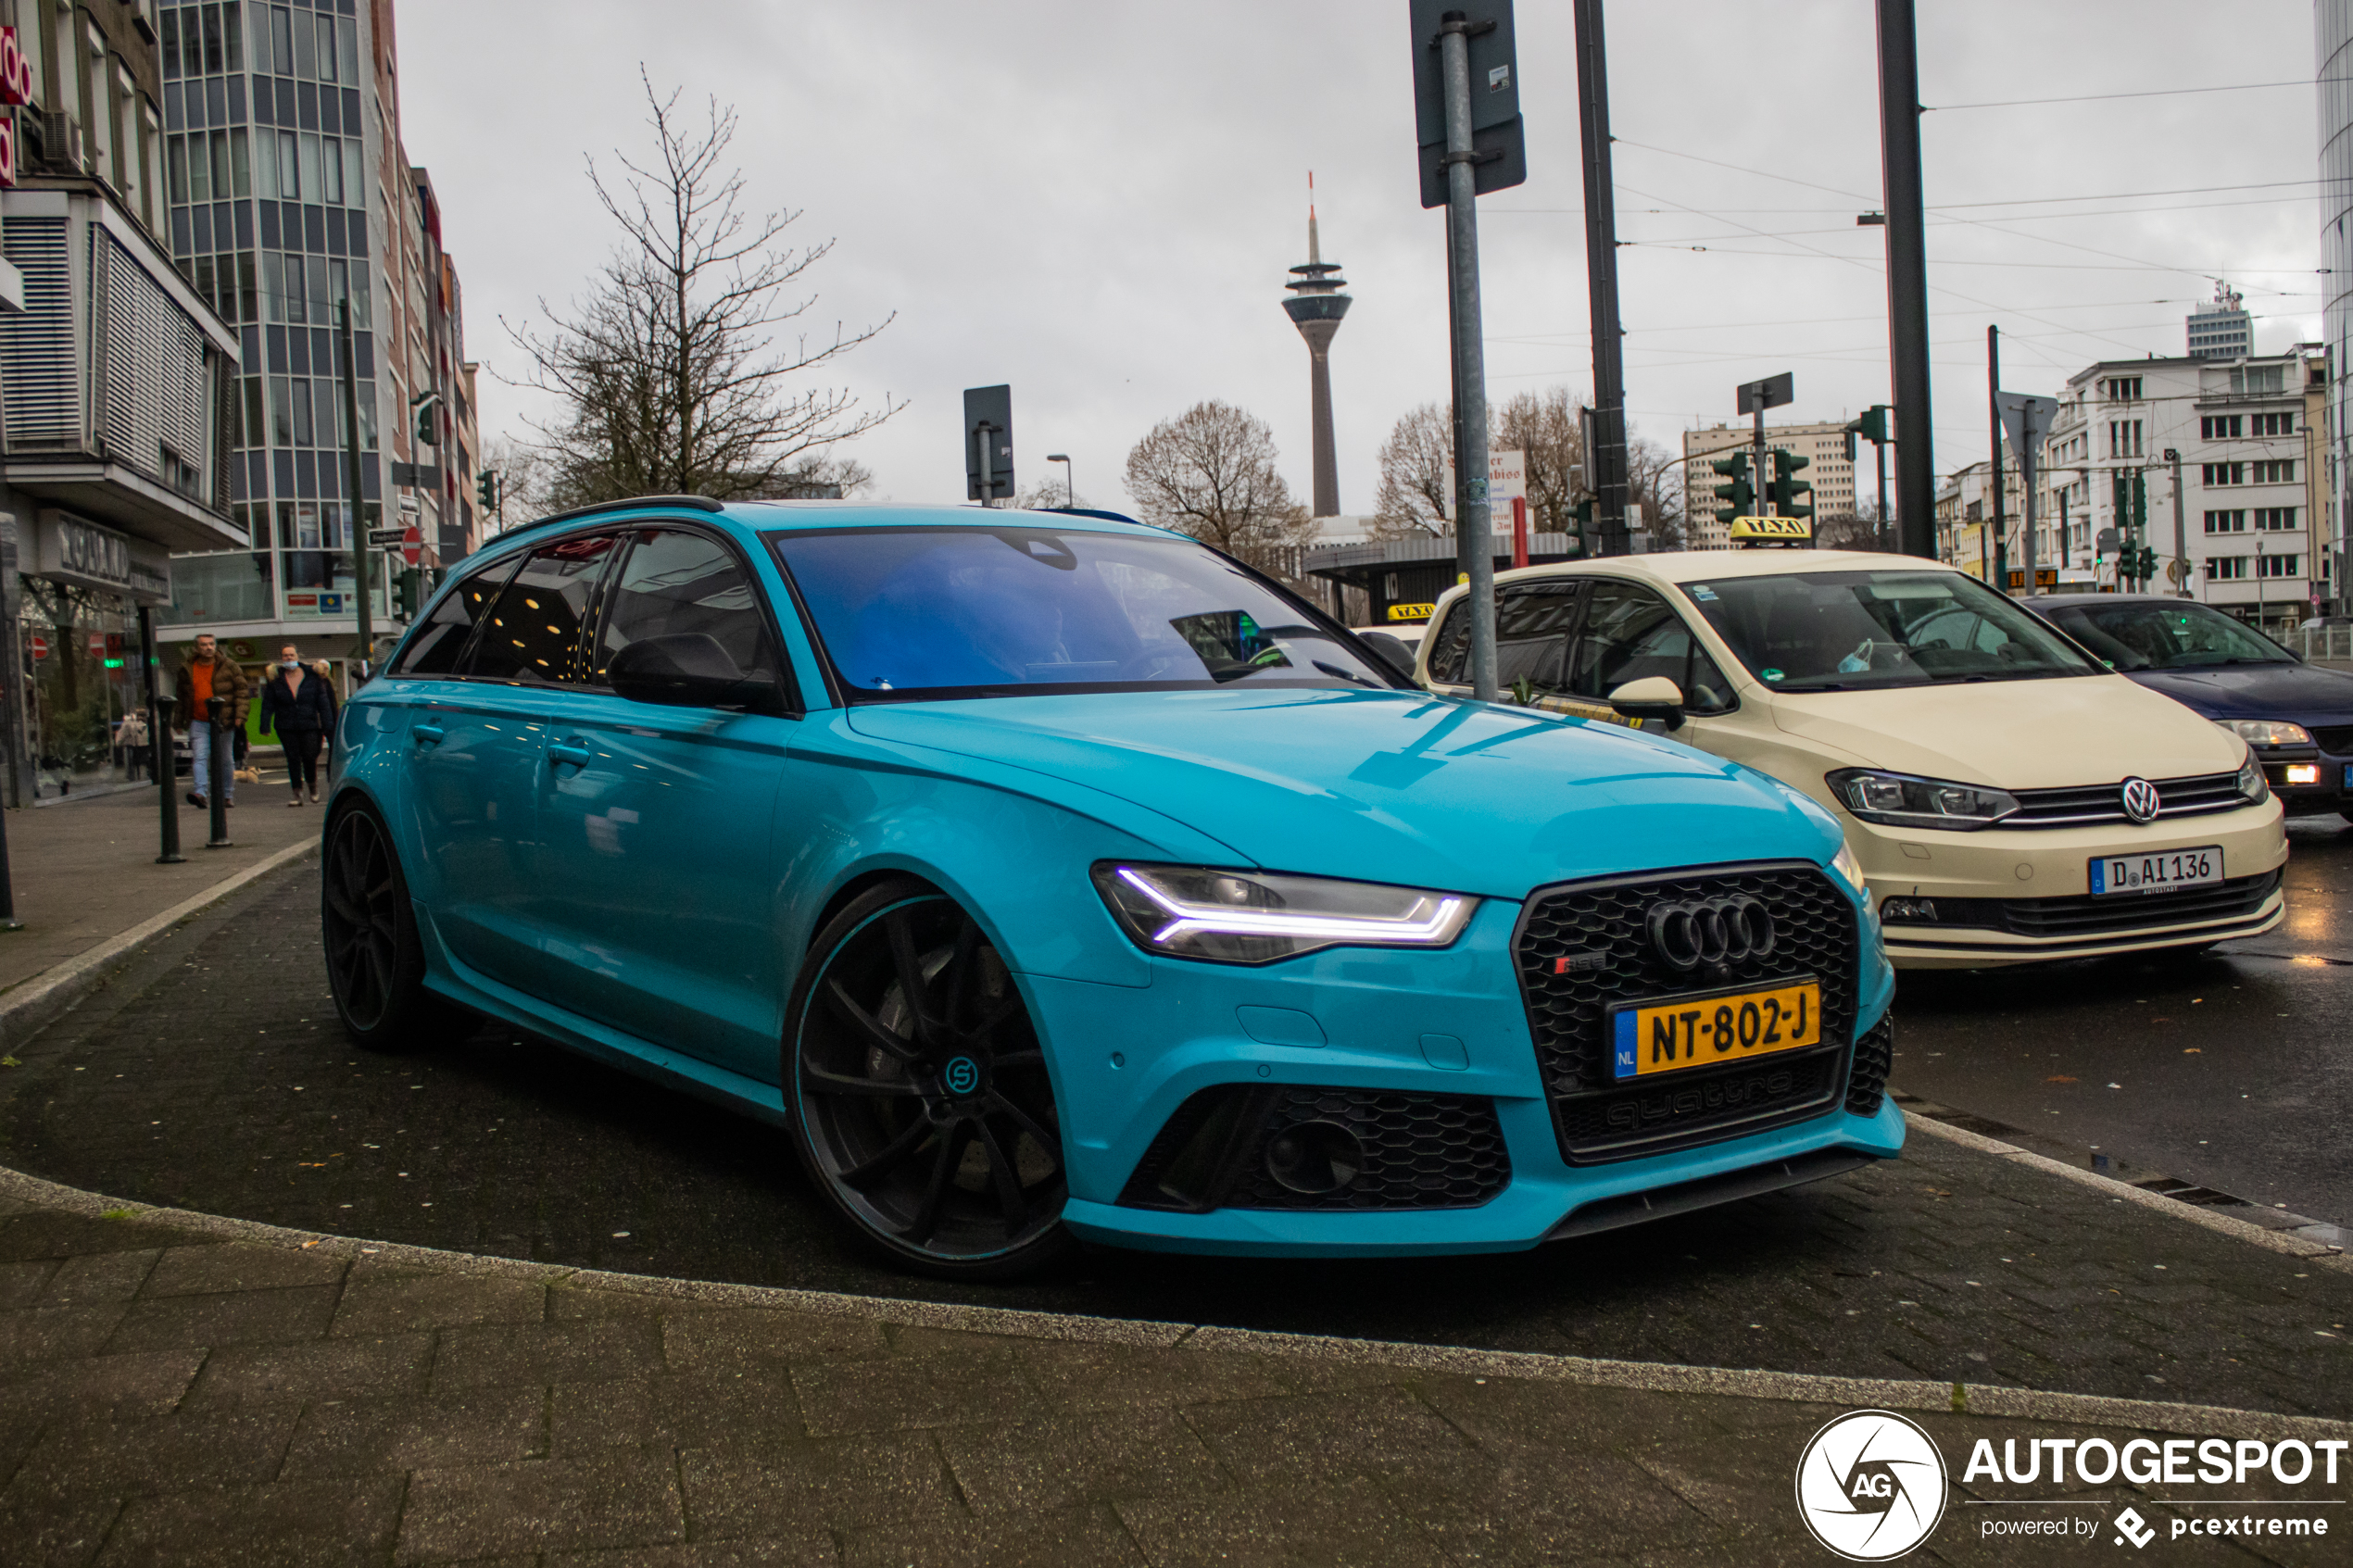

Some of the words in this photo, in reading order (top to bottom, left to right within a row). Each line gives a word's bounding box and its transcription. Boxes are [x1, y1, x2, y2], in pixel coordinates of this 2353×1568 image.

[1745, 520, 1804, 534] TAXI
[1398, 606, 1435, 619] TAXI
[2112, 861, 2127, 886] D
[2142, 858, 2168, 884] AI
[2171, 853, 2210, 881] 136
[2143, 885, 2178, 896] AUTOSTADT
[1653, 992, 1806, 1063] NT-802-J
[1618, 1051, 1634, 1066] NL
[1607, 1072, 1793, 1129] quattro
